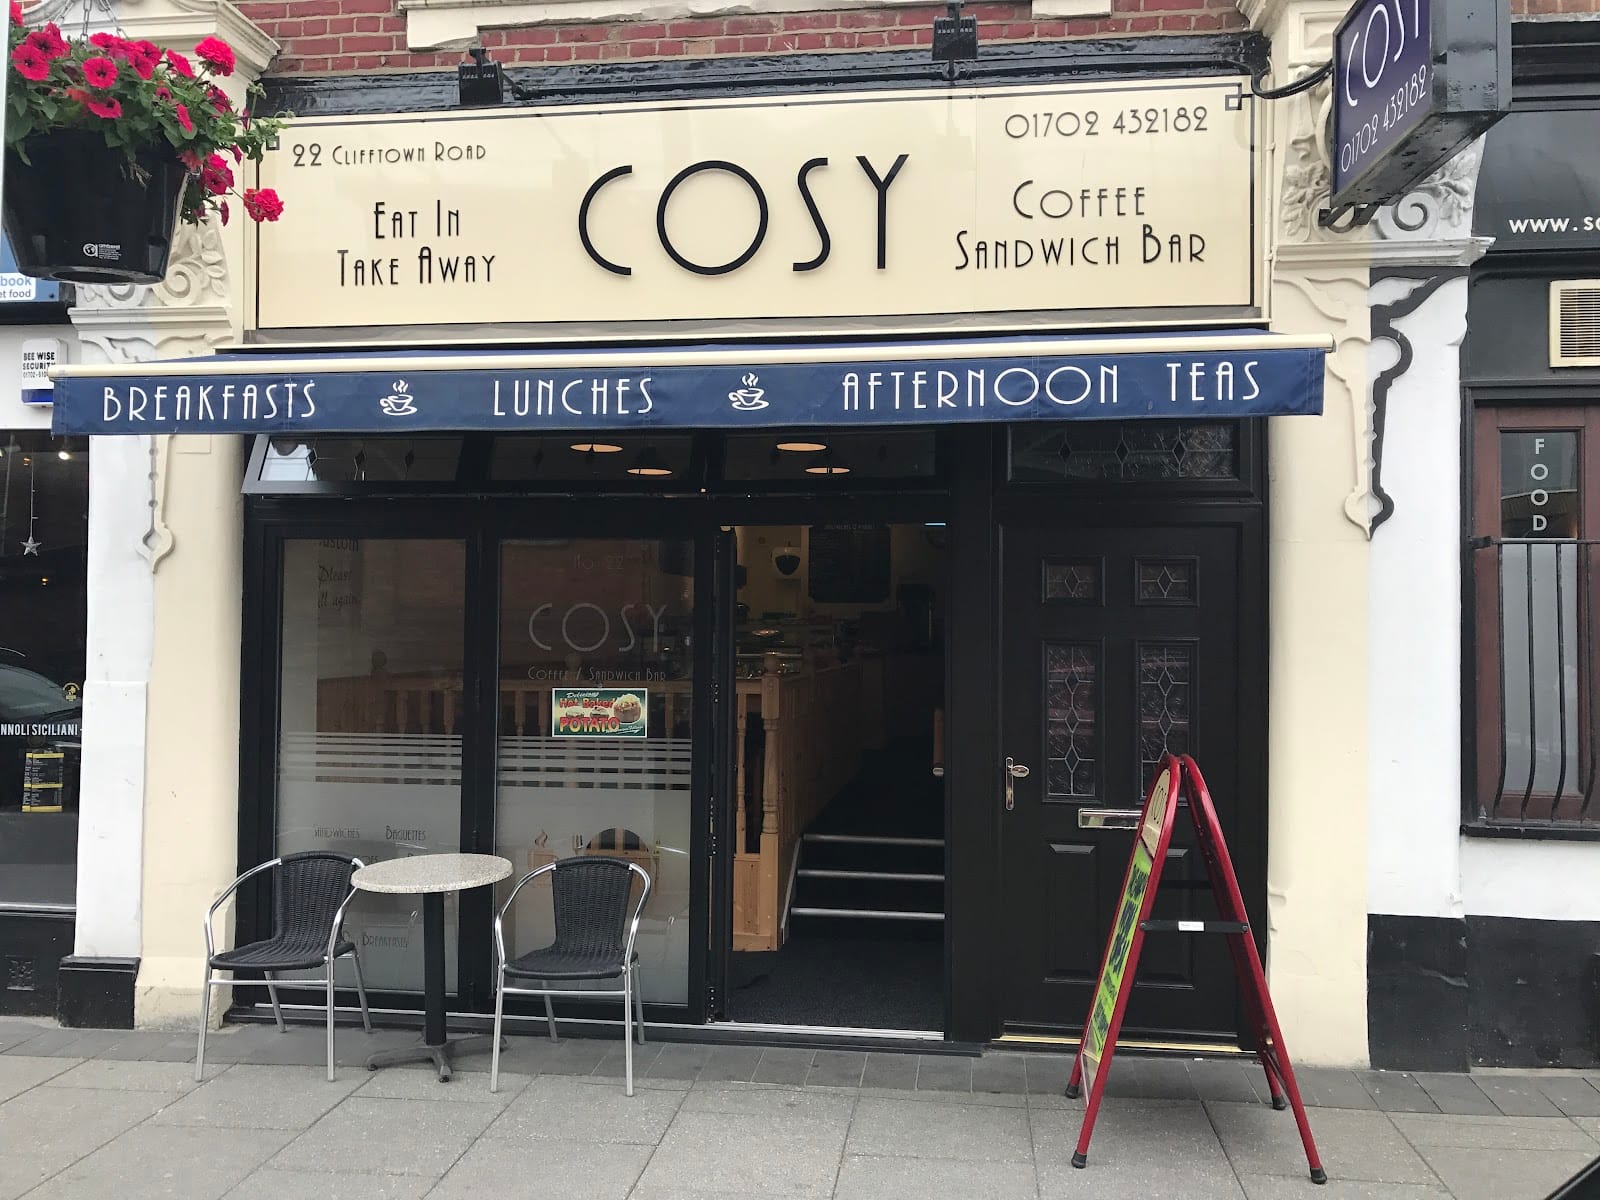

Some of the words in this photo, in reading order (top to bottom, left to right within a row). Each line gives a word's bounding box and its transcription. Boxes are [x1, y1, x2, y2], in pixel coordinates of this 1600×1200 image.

[1005, 110, 1099, 139] 01702
[1113, 105, 1208, 134] 432182
[1341, 113, 1379, 173] 01702
[1383, 64, 1427, 133] 432182
[292, 143, 323, 167] 22
[332, 145, 426, 166] CLIFFTOWN
[435, 141, 487, 161] ROAD
[578, 153, 909, 276] COSY
[1013, 180, 1146, 219] COFFEE
[374, 201, 418, 239] EAT
[437, 200, 460, 237] IN
[955, 229, 1121, 270] SANDWICH
[1142, 223, 1207, 264] BAR
[337, 249, 400, 287] TAKE
[418, 246, 496, 285] AWAY
[9, 288, 31, 298] food
[23, 352, 35, 361] BEE
[37, 351, 55, 361] WISE
[103, 382, 317, 422] BREAKFASTS
[493, 377, 654, 417] LUNCHES
[842, 365, 1119, 413] AFTERNOON
[1167, 361, 1261, 402] TEAS
[1530, 438, 1549, 531] FOOD
[528, 602, 666, 652] COSY
[528, 666, 568, 681] COFFEE
[589, 666, 641, 681] SANDWICH
[646, 667, 666, 682] BAR
[0, 723, 30, 736] NNOLI
[31, 723, 78, 736] SICILIANI
[560, 716, 620, 732] POTATO
